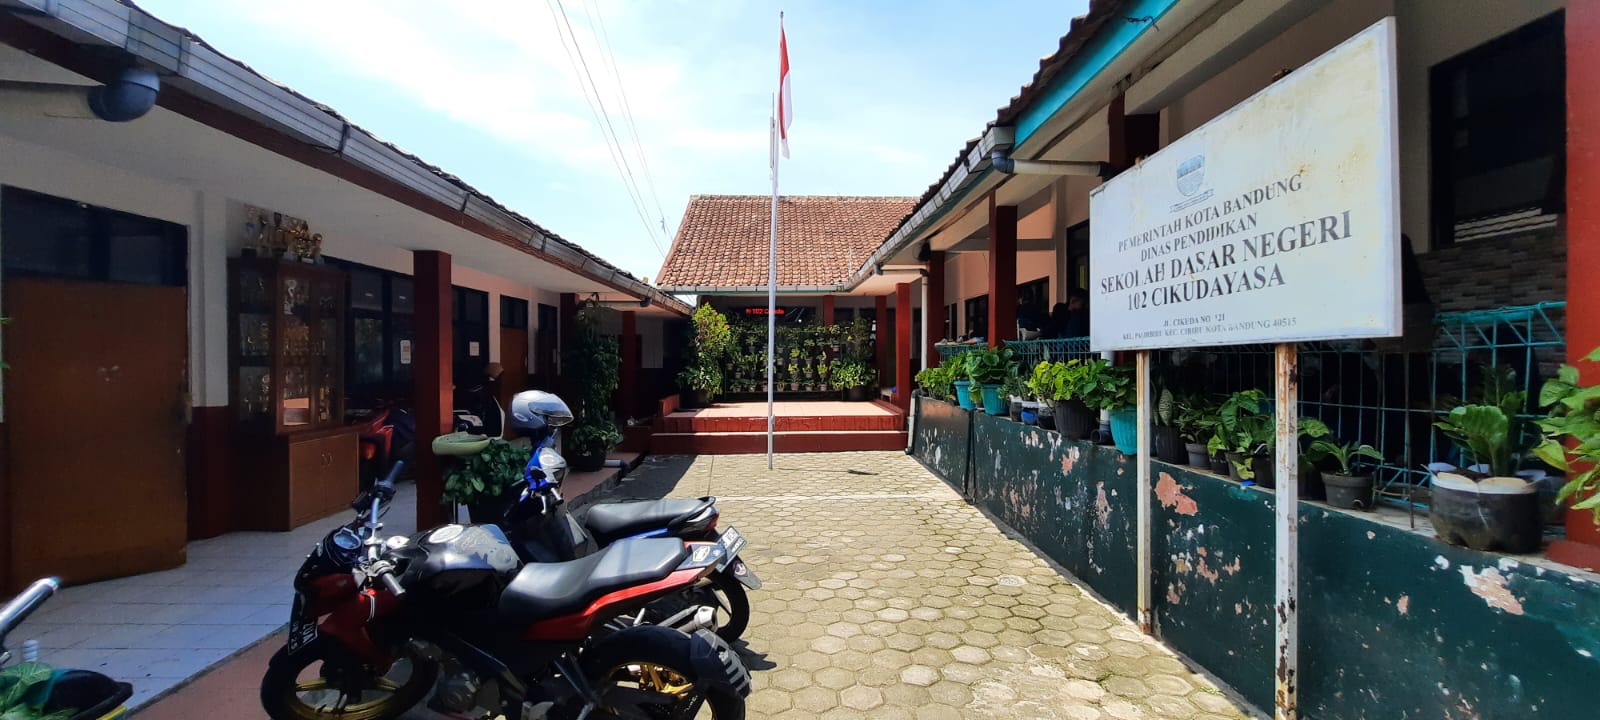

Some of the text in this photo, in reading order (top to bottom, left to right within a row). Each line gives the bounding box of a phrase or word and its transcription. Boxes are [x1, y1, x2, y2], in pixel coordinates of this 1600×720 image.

[1118, 218, 1182, 253] PEMERINTAH
[1185, 206, 1220, 228] KOTA
[1223, 174, 1301, 216] BANDUNG
[1140, 212, 1258, 262] DINAS PENDIDIKAN
[1171, 243, 1236, 279] DASAR
[1243, 209, 1353, 262] NEGERI
[1127, 262, 1286, 311] 102 CIKUDAYASA
